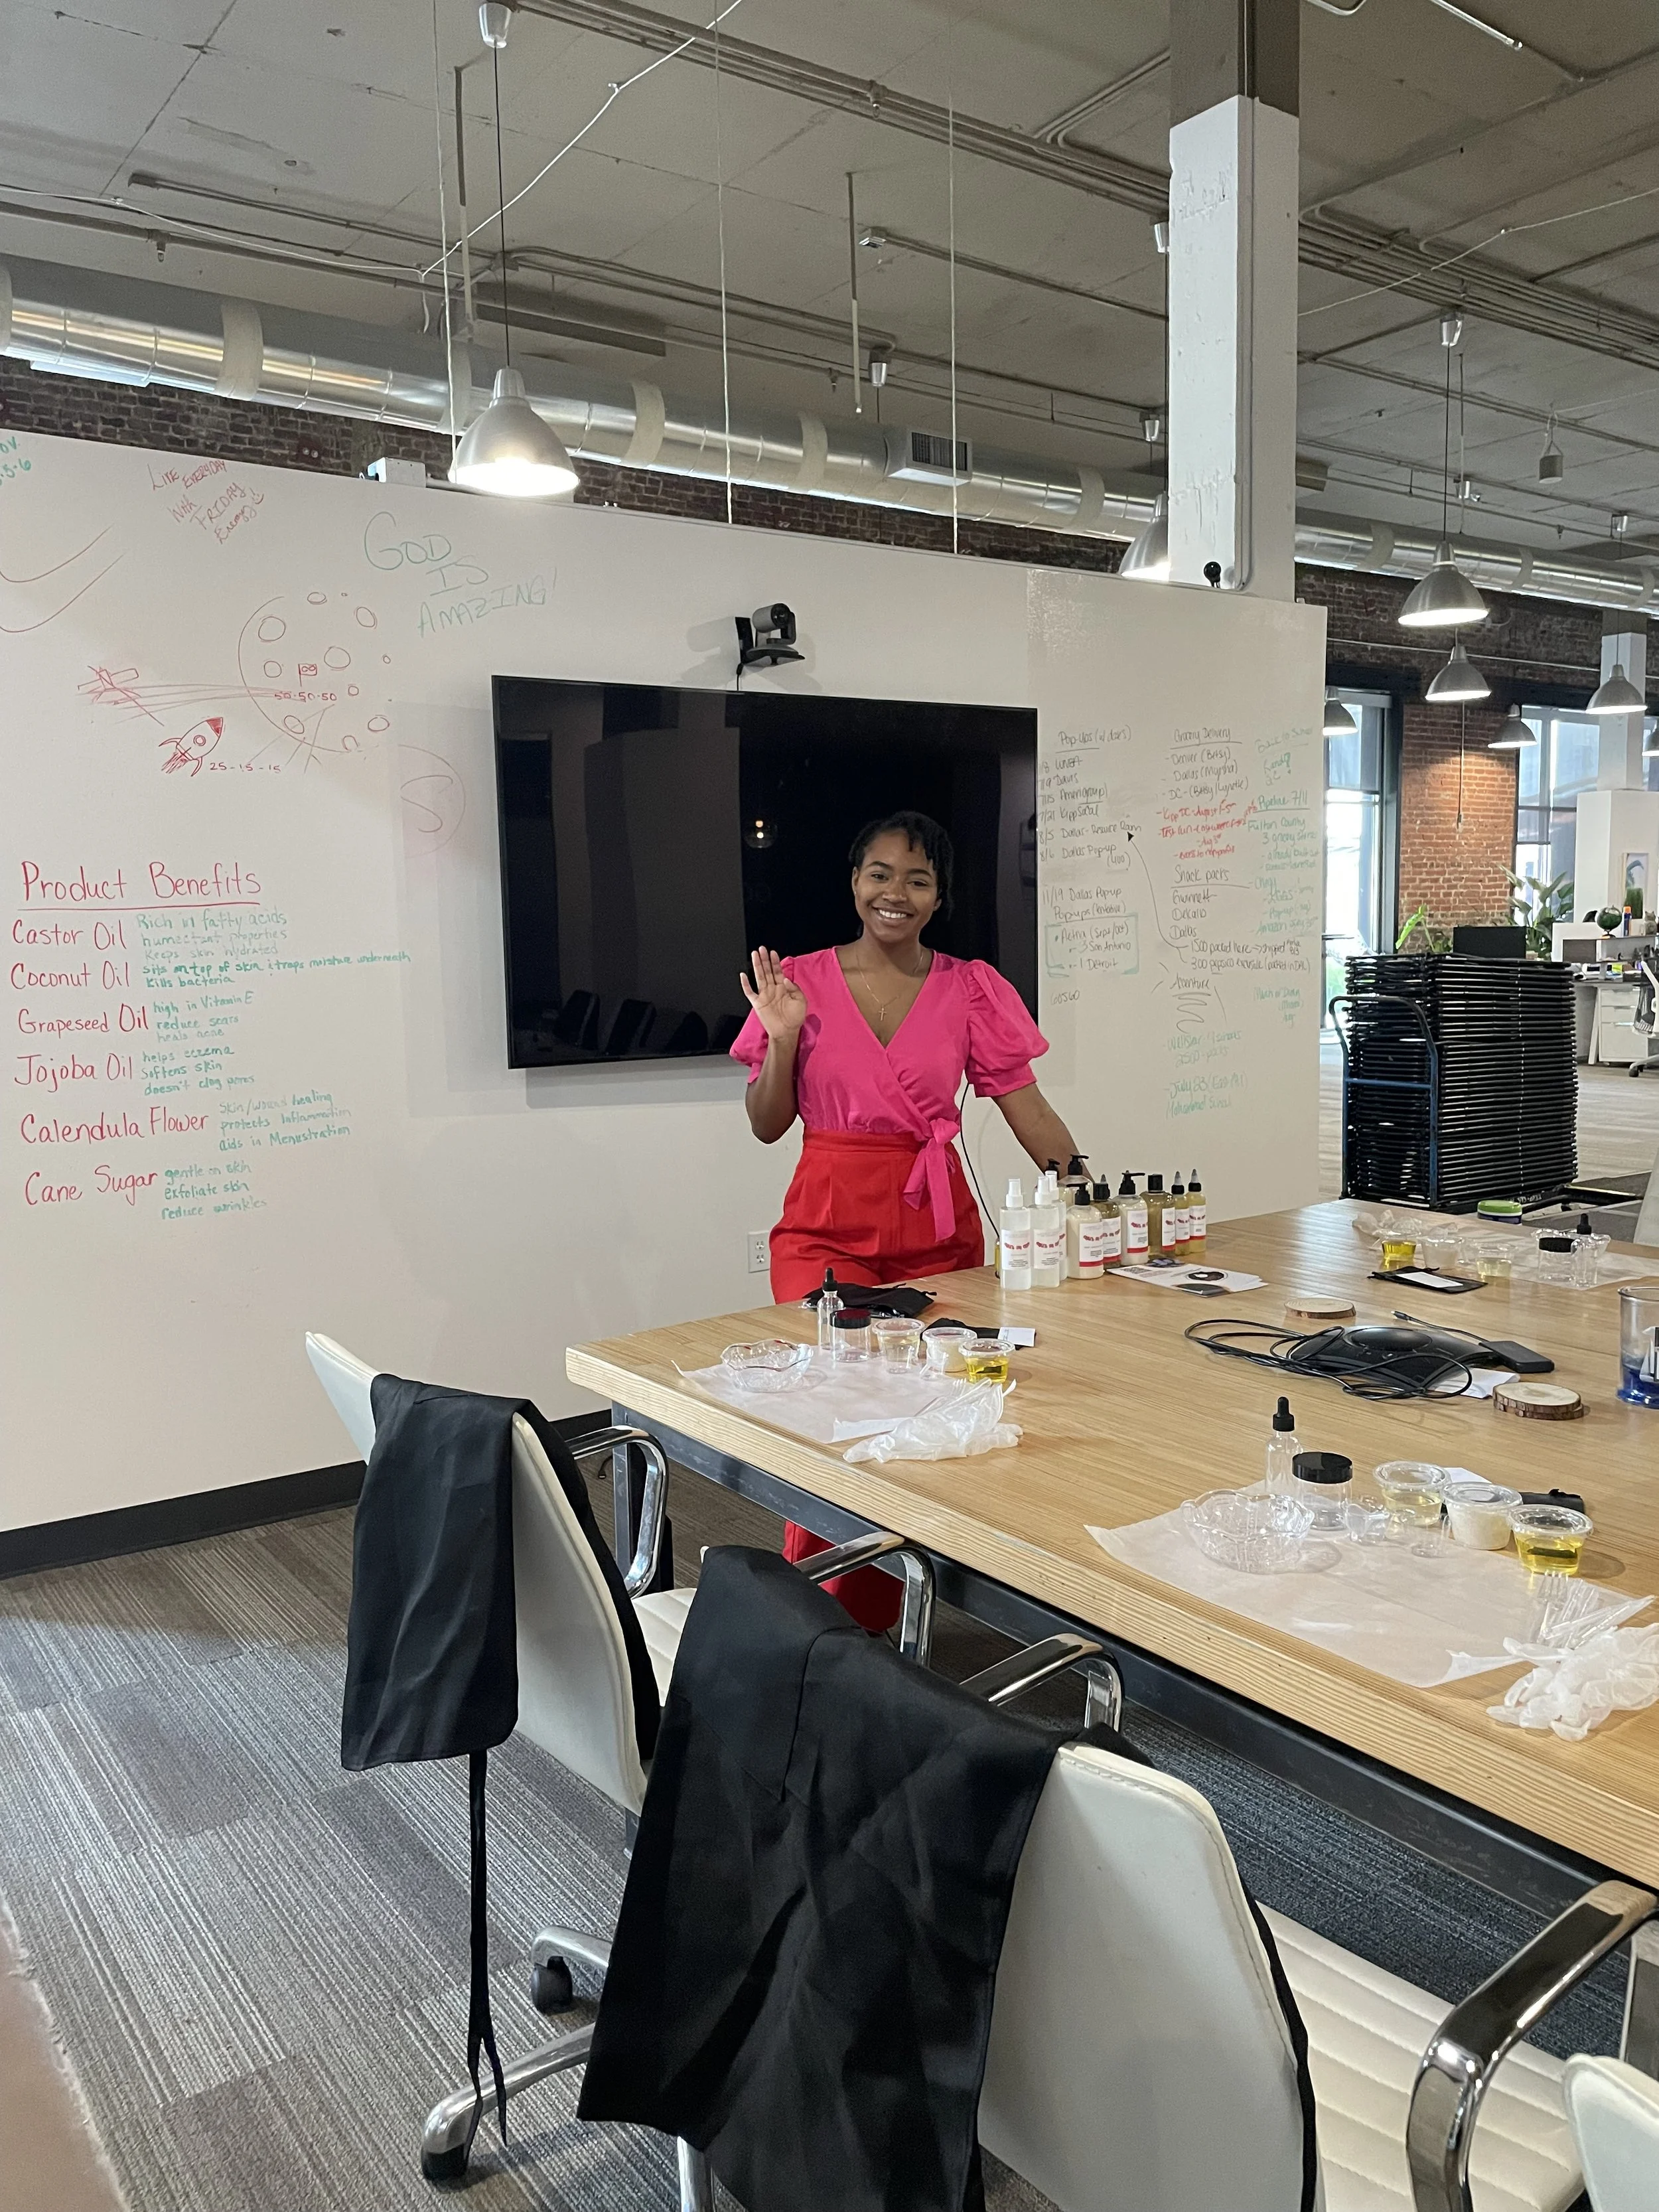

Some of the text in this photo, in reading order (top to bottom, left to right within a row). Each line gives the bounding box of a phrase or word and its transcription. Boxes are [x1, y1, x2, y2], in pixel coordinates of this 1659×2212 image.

[182, 459, 227, 489] EVERYDAY
[190, 482, 246, 530] FRIDAY
[425, 555, 489, 597] IS
[21, 860, 261, 902] Product Benefits
[1175, 864, 1202, 884] Snack
[1069, 887, 1093, 901] Dallas
[136, 913, 173, 930] Rich
[201, 908, 243, 932] fatty
[249, 905, 288, 926] acids
[13, 919, 127, 950] Castor Oil
[1169, 924, 1197, 940] Dallas
[190, 947, 214, 958] skin
[224, 940, 279, 960] hydrated
[189, 961, 212, 978] top
[218, 960, 230, 974] of
[235, 960, 264, 973] skin
[1087, 957, 1119, 971] Detroit
[1191, 956, 1208, 970] 300
[11, 960, 131, 990] Coconut Oil
[179, 973, 236, 988] bacteria
[153, 990, 255, 1019] high in Vitamin E
[18, 1003, 149, 1039] Grapeseed Oil
[157, 1016, 201, 1031] reduce
[142, 1046, 235, 1065] helps eczema
[15, 1052, 133, 1093] Jojoba Oil
[194, 1059, 222, 1073] skin
[144, 1079, 191, 1096] doesn't
[198, 1076, 222, 1090] clog
[292, 1088, 334, 1107] healing
[21, 1105, 210, 1145] Calendula Flower
[220, 1115, 271, 1137] protects
[219, 1137, 244, 1151] aids
[249, 1136, 262, 1147] in
[165, 1163, 205, 1186] gentle
[225, 1159, 252, 1174] skin
[25, 1164, 159, 1207] Cane Sugar
[165, 1179, 250, 1200] exfoliate skin
[161, 1205, 204, 1220] reduce
